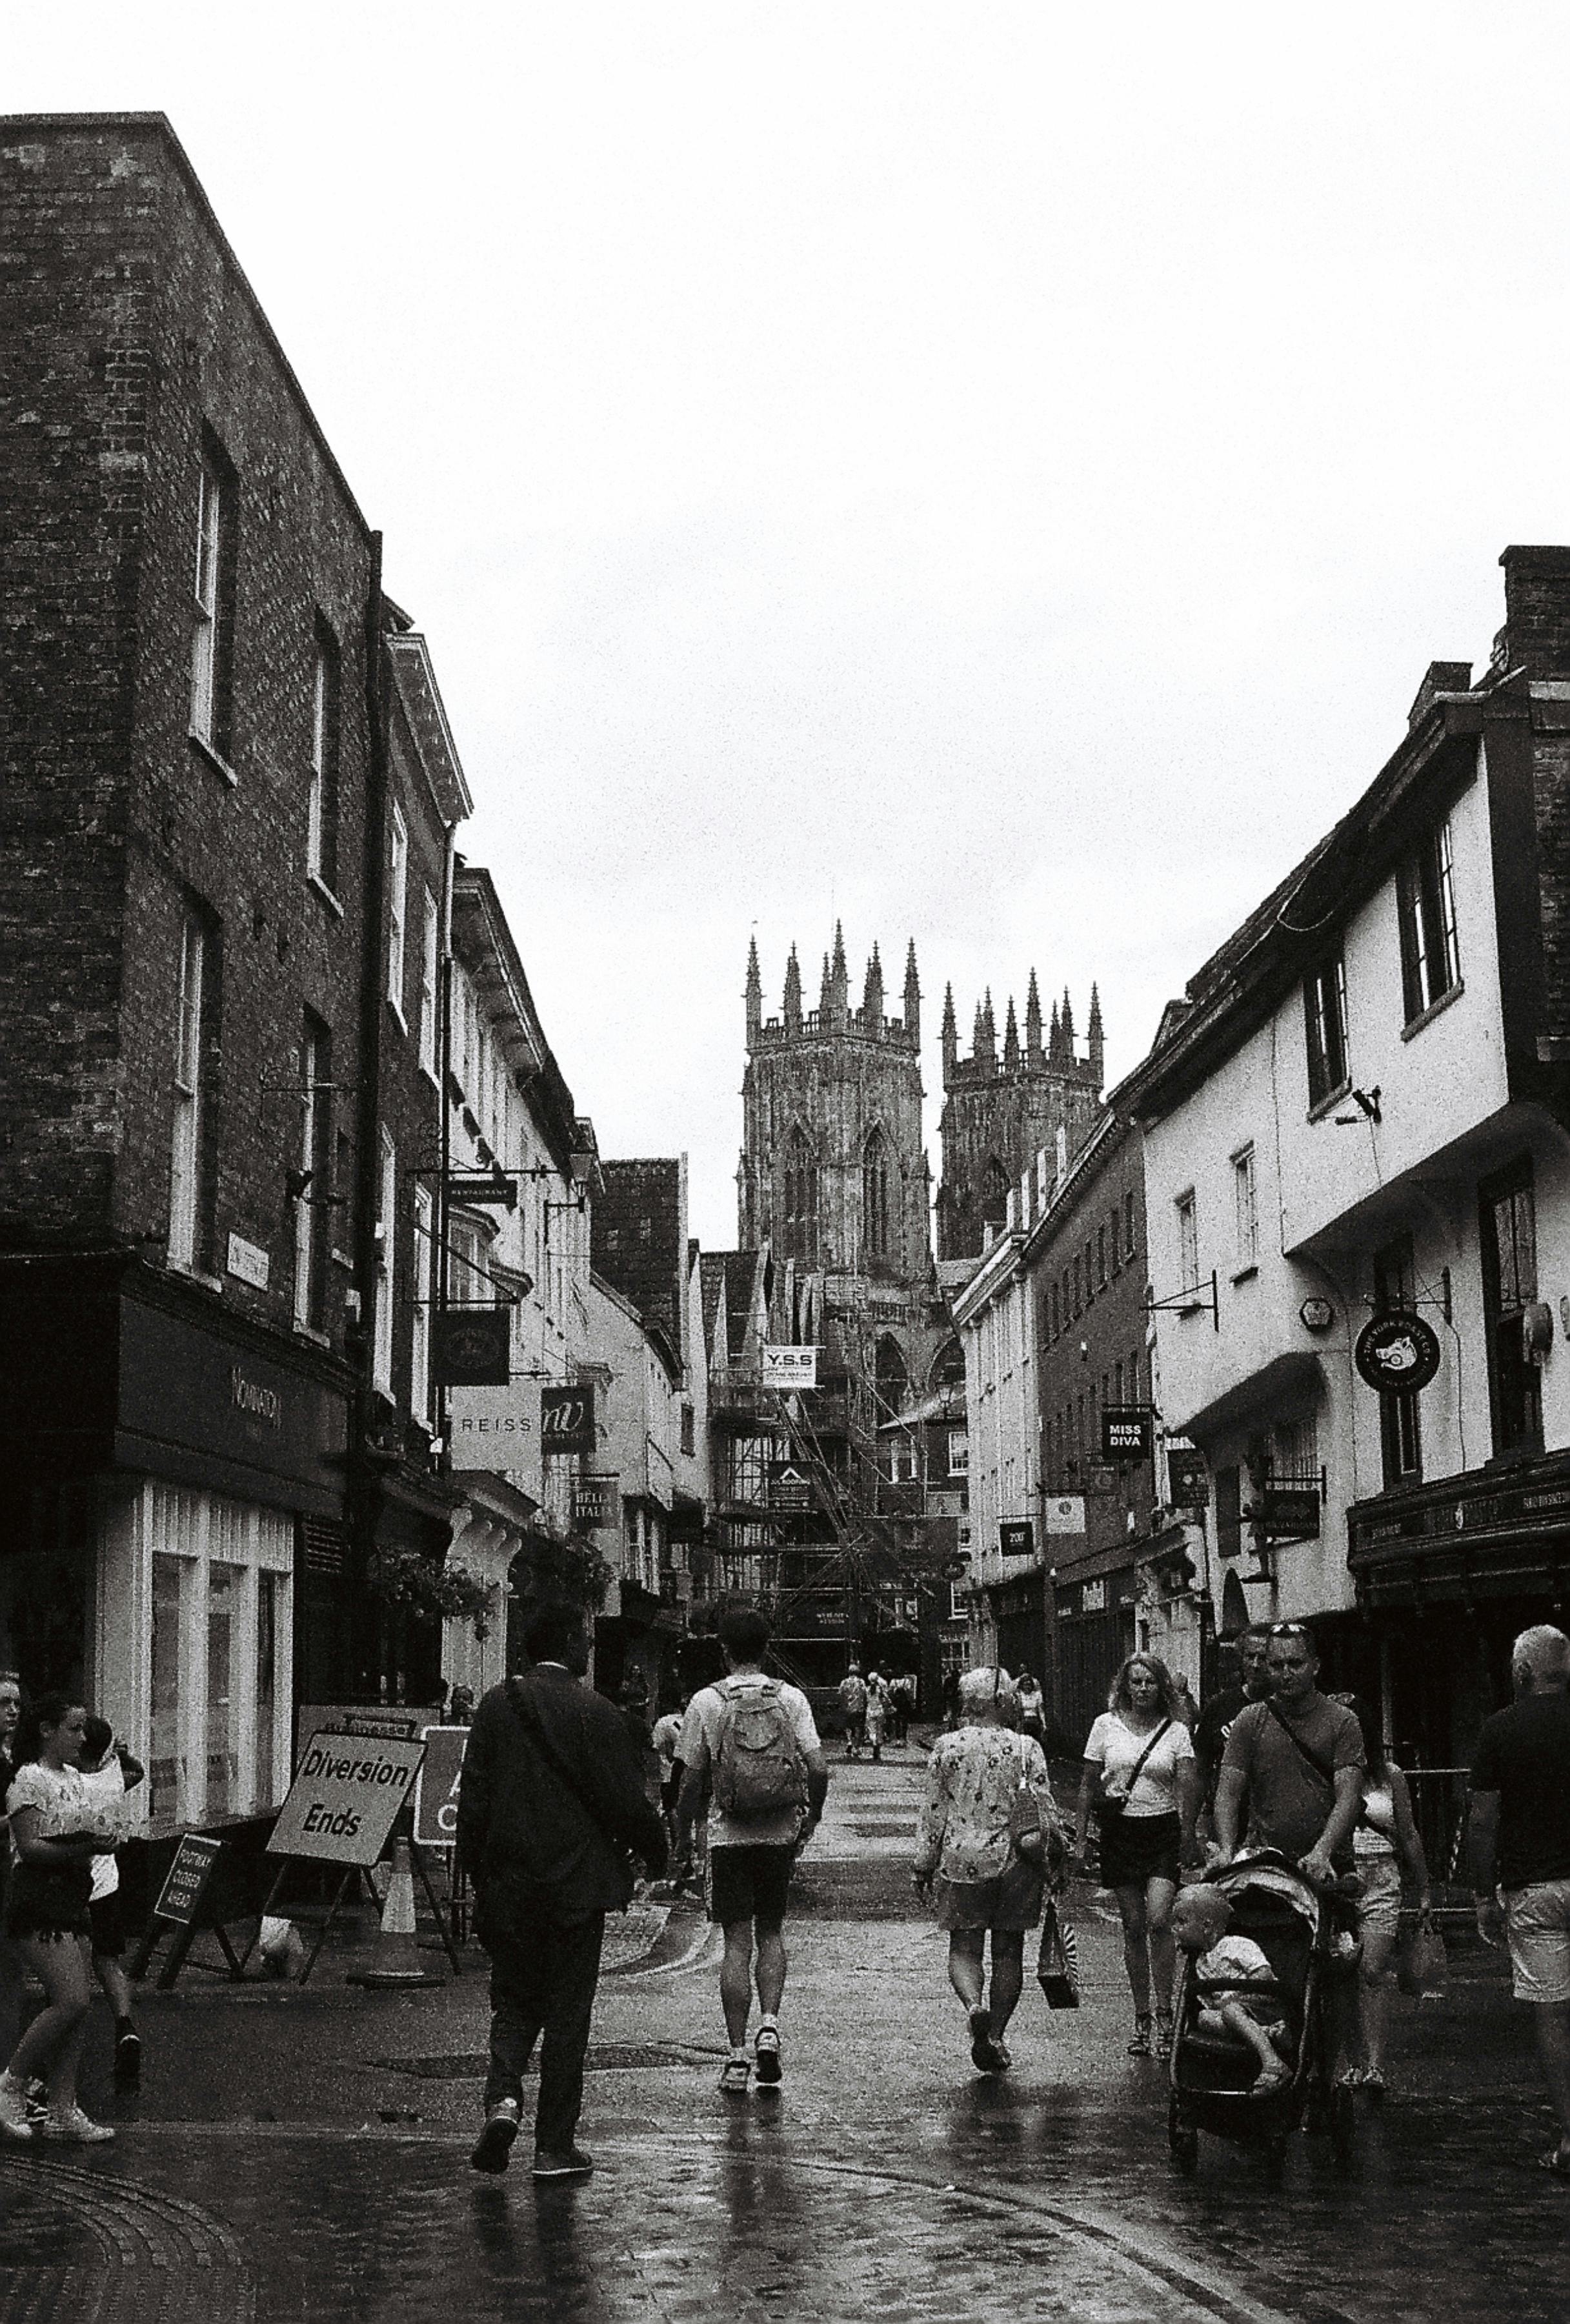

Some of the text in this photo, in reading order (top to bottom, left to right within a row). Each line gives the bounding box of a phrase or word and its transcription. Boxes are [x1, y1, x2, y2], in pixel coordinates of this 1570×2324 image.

[1363, 1335, 1376, 1354] THE
[1371, 1320, 1397, 1336] YORK
[1398, 1320, 1427, 1340] ROAST
[461, 1418, 532, 1432] REISS
[1109, 1424, 1142, 1435] MISS
[1110, 1436, 1142, 1447] DIVA
[303, 1750, 408, 1787] Diversion
[302, 1804, 361, 1836] Ends
